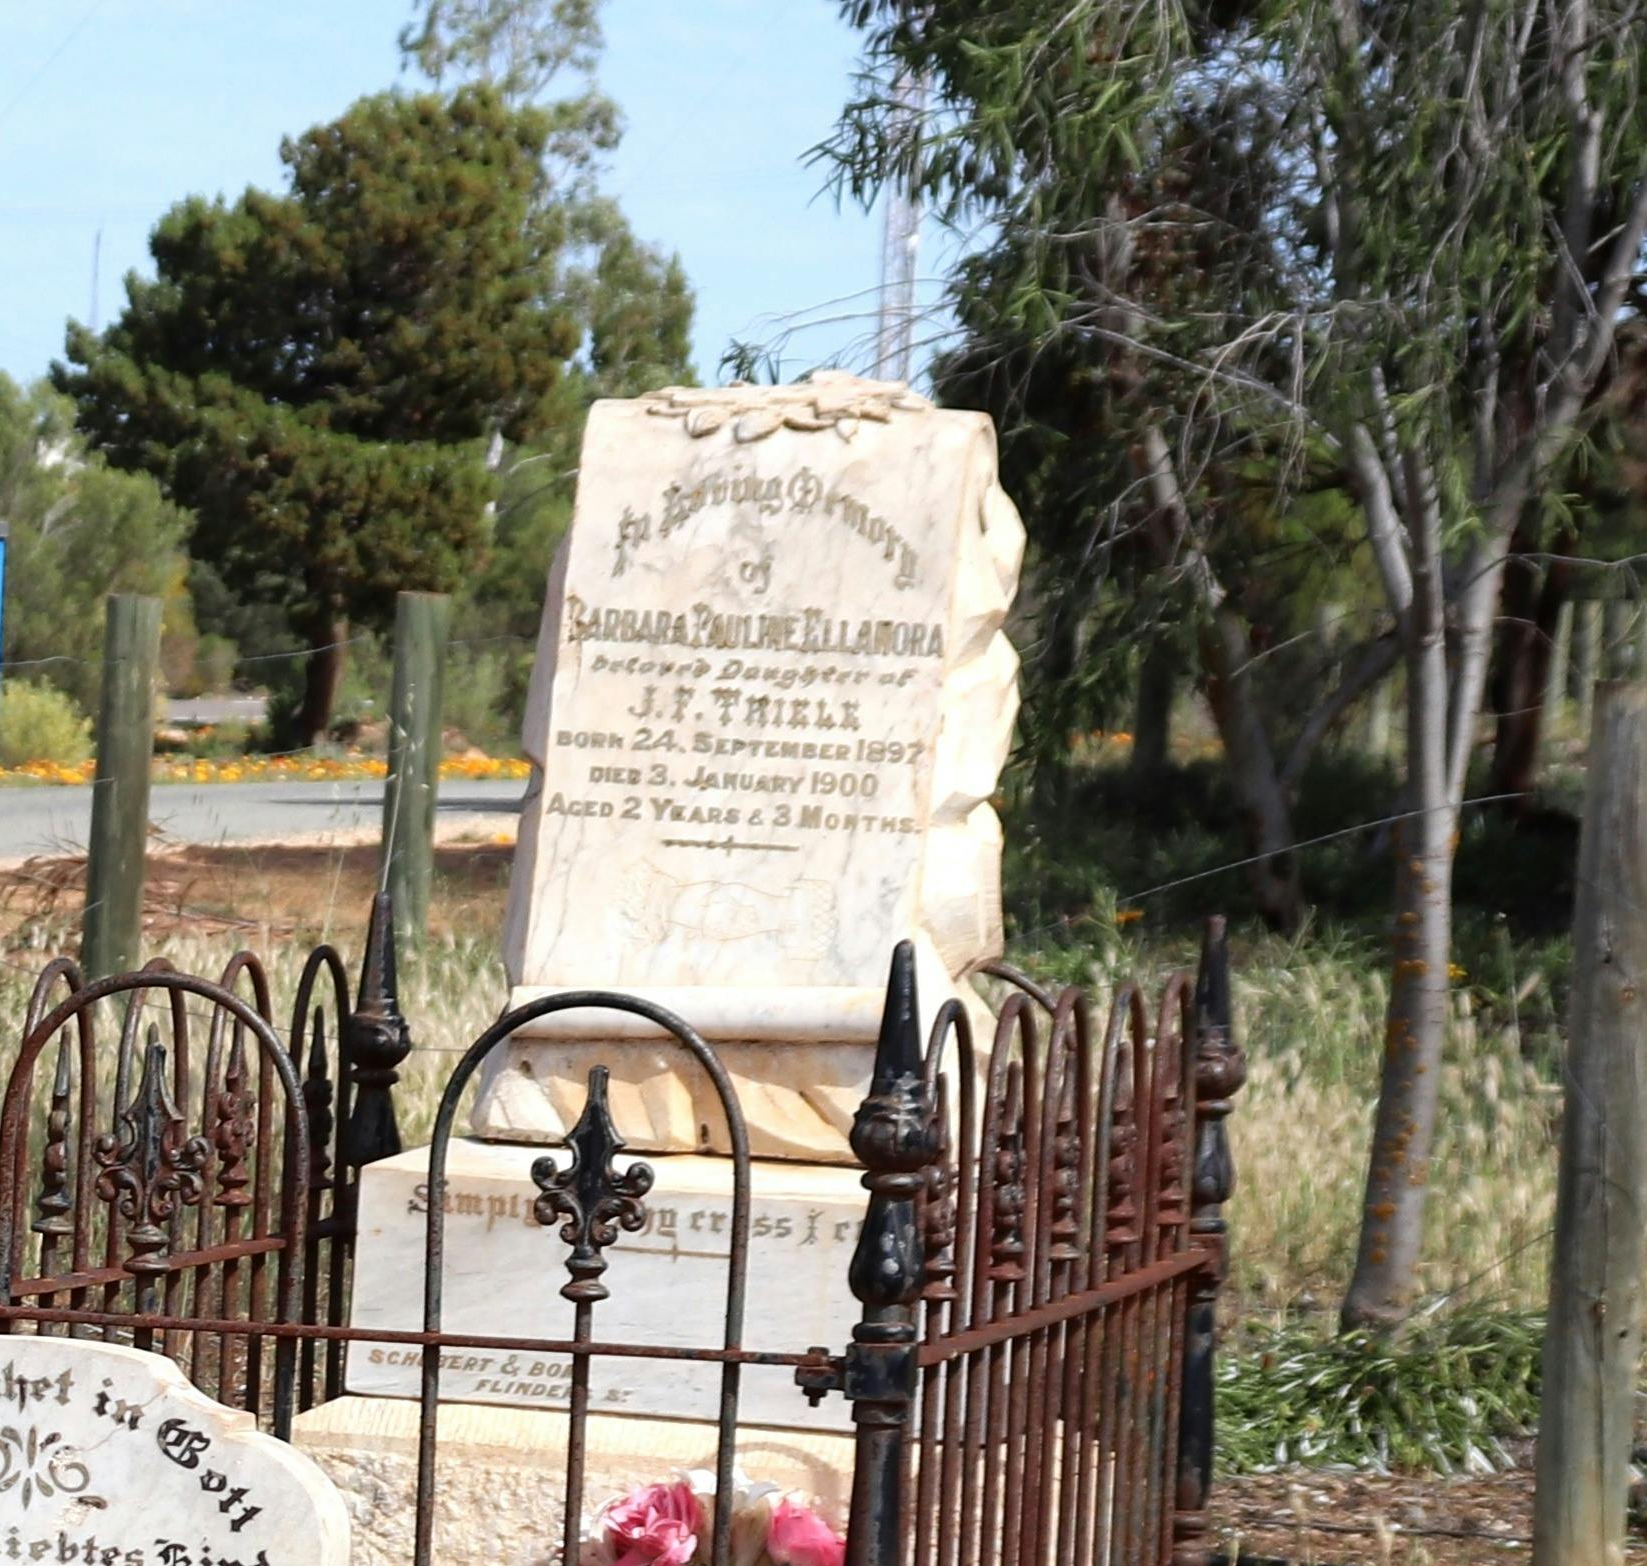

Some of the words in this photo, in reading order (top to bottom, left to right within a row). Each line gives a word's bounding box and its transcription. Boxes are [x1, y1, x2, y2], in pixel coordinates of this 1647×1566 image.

[739, 551, 774, 595] of
[810, 770, 880, 797] 1900
[620, 796, 643, 821] 2
[771, 803, 794, 829] 3
[690, 1208, 793, 1238] crss
[500, 1353, 520, 1378] &
[92, 1377, 144, 1430] in
